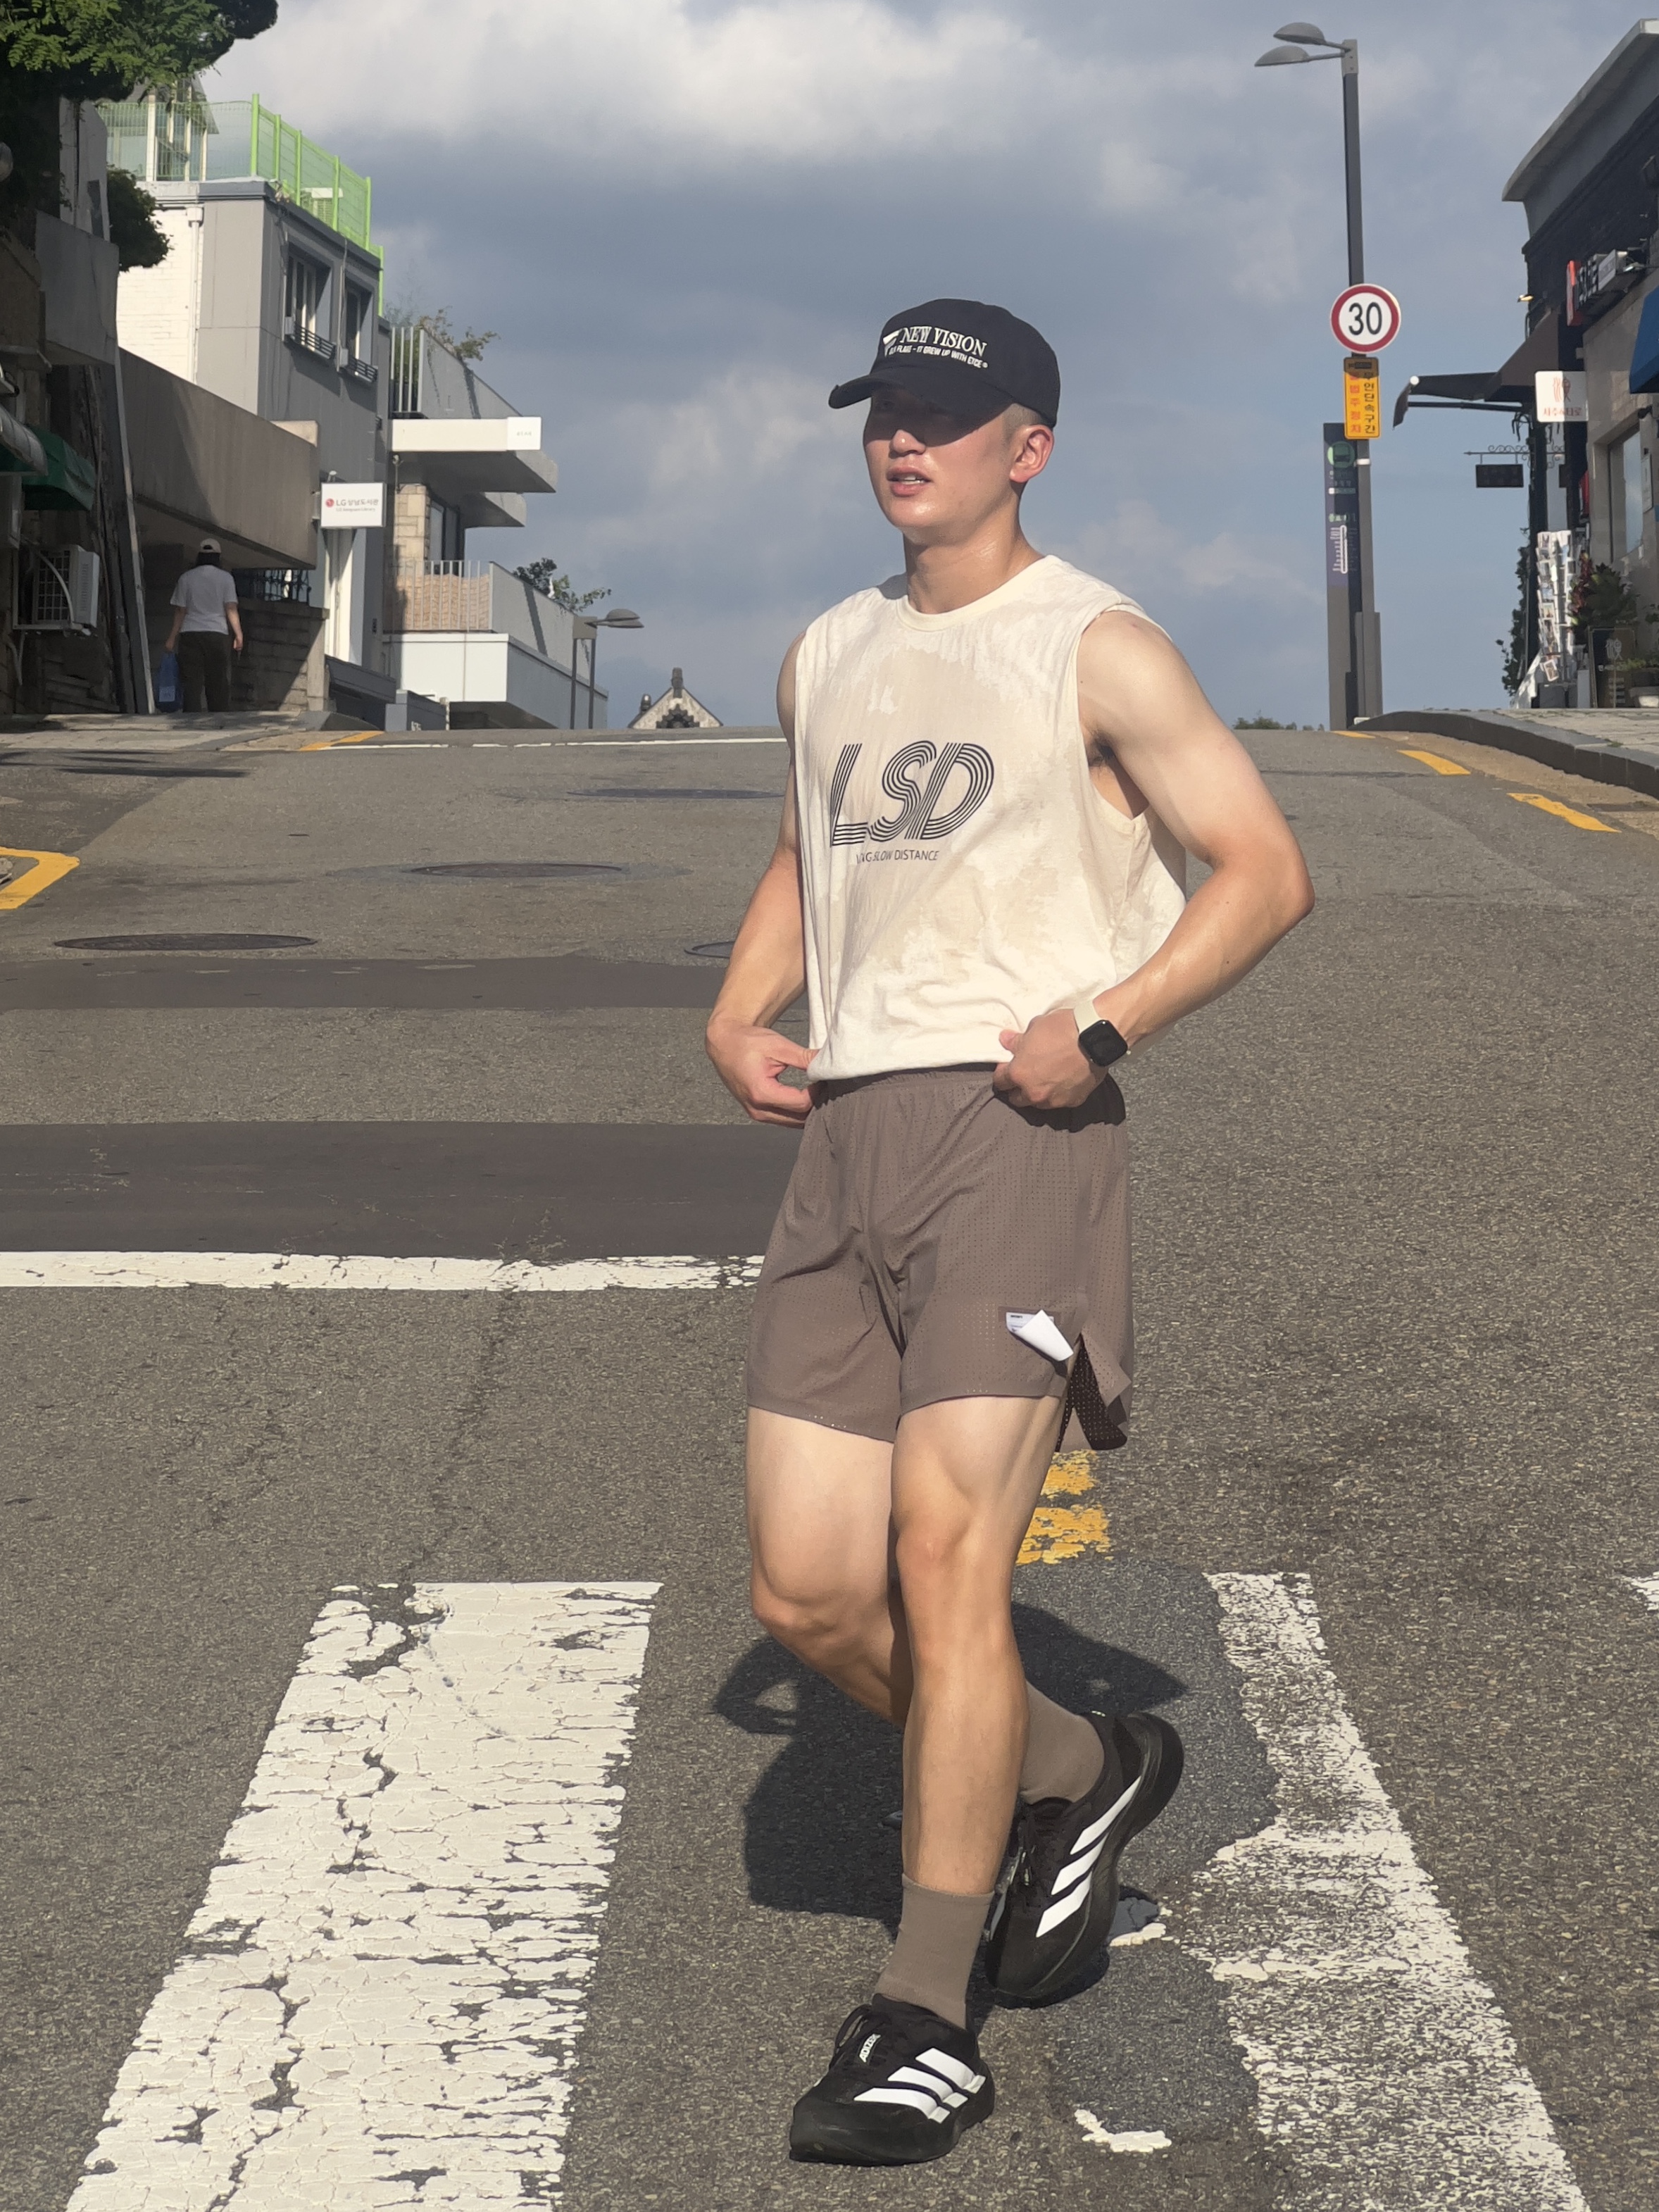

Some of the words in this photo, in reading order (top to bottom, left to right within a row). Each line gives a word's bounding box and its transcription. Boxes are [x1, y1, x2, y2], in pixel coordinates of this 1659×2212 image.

[1348, 301, 1382, 335] 30
[900, 326, 932, 343] NEW
[933, 327, 987, 357] VISION
[830, 740, 994, 848] LSD
[894, 849, 939, 861] DISTANCE
[859, 2034, 881, 2063] ADIZER
